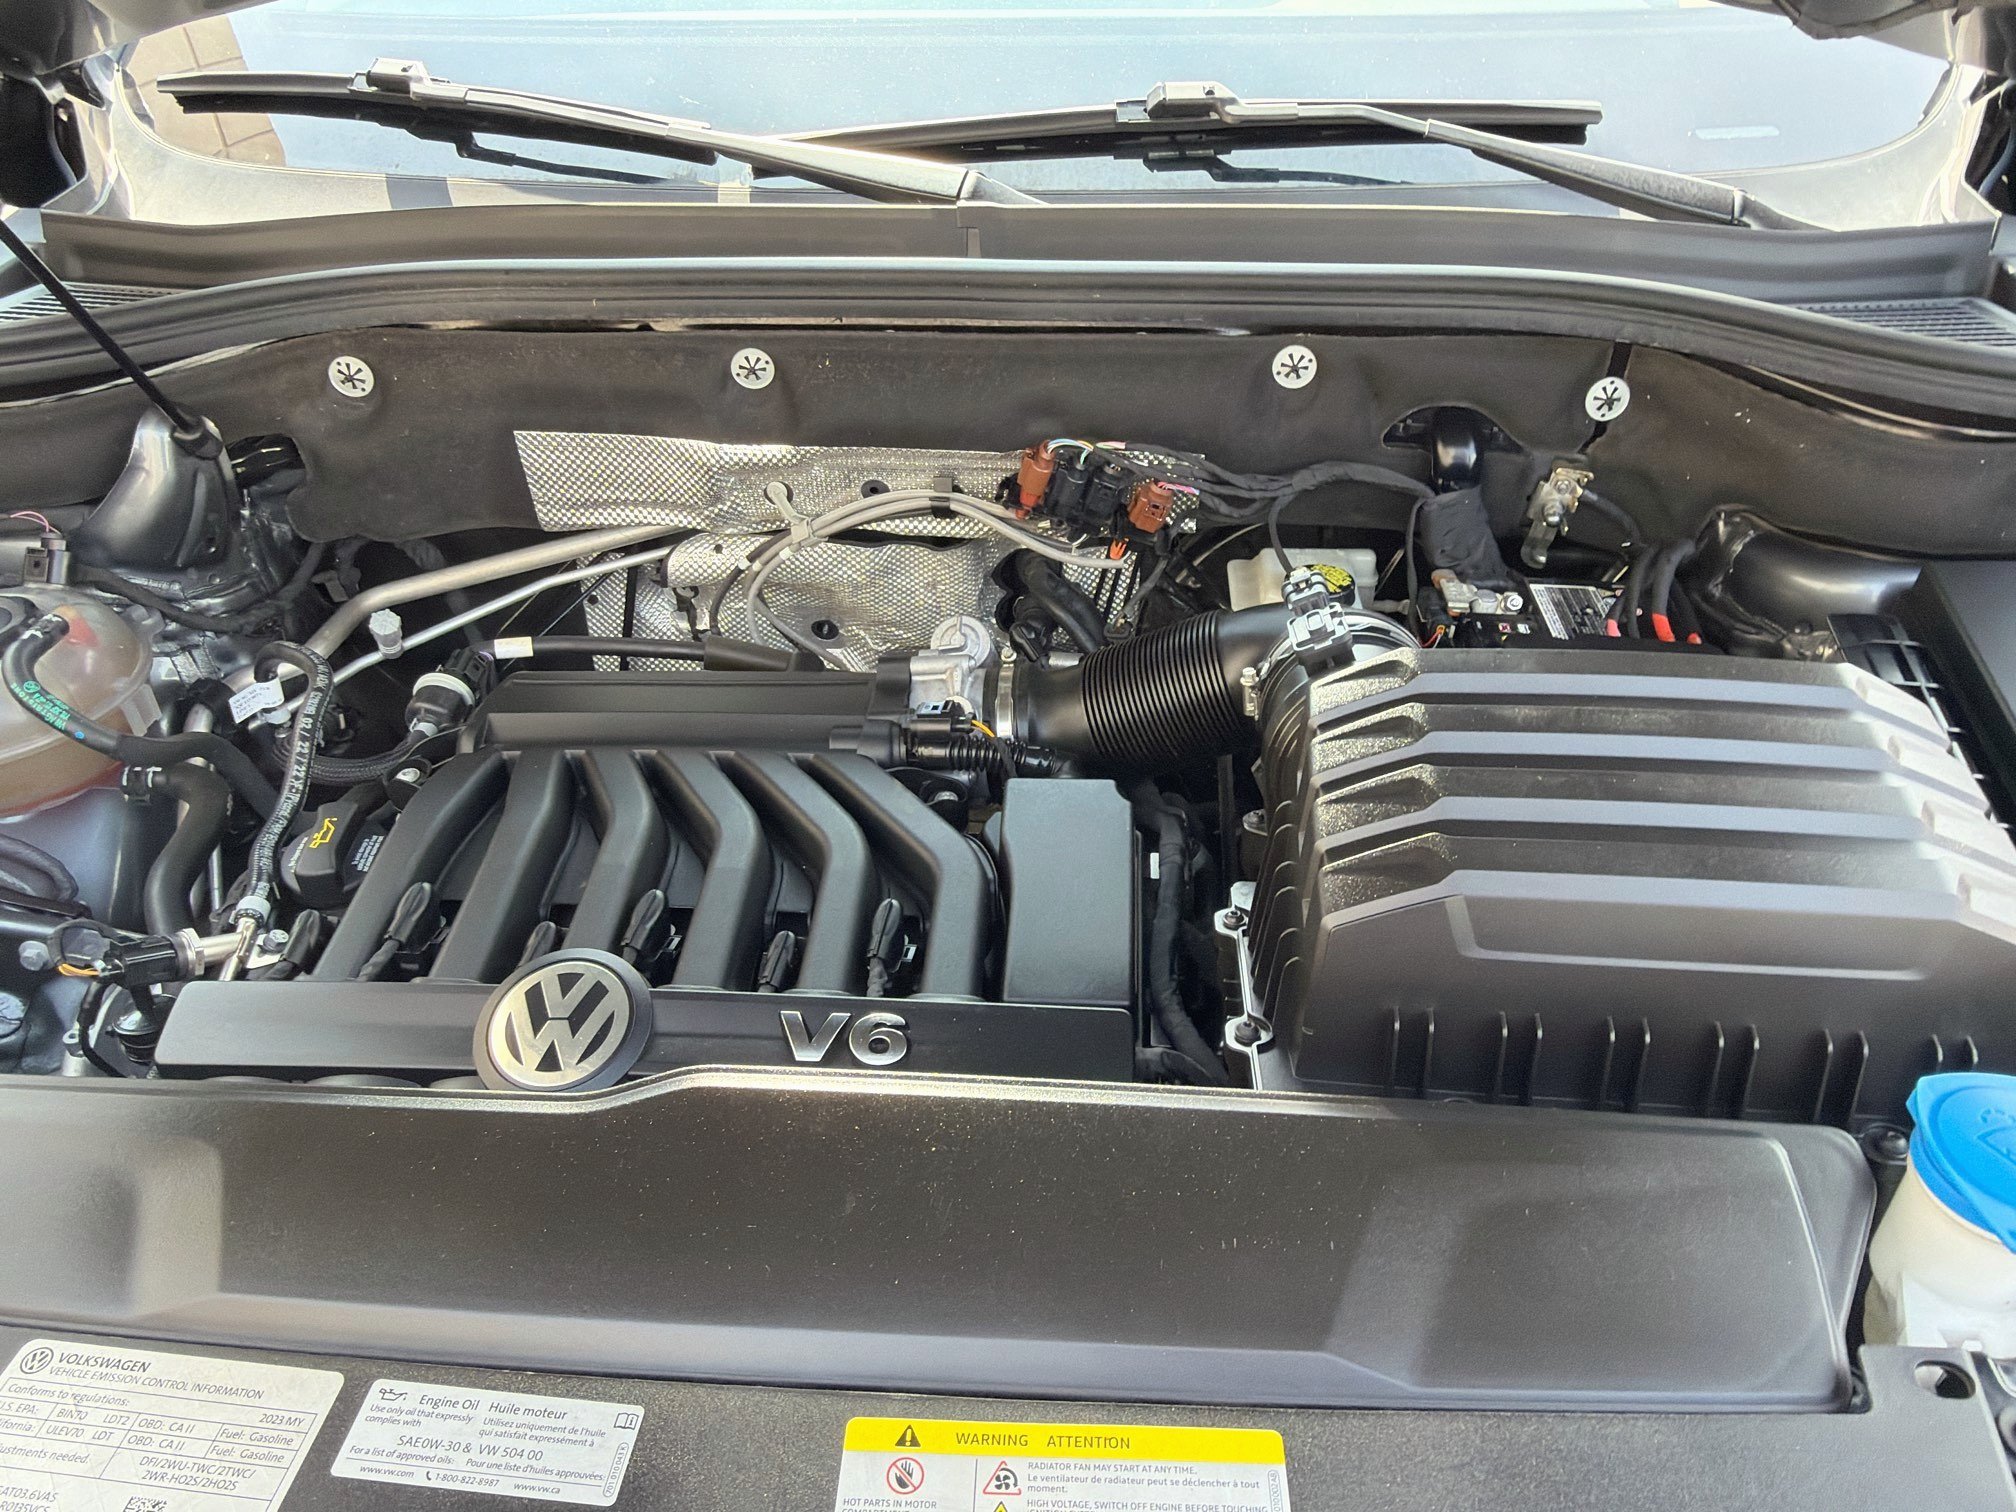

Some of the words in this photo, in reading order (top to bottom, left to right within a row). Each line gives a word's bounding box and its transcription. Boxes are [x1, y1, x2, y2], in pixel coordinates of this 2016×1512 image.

[778, 1009, 908, 1067] V6
[58, 1352, 152, 1373] VOLKSWAGEN
[49, 1366, 93, 1379] VEHICLE
[90, 1370, 142, 1385] EMISSION
[141, 1376, 189, 1391] CONTROL
[190, 1383, 265, 1400] INFORMATION
[8, 1383, 56, 1398] Conforms
[58, 1389, 69, 1400] to
[70, 1391, 130, 1407] regulations:
[419, 1394, 460, 1410] Engine
[461, 1399, 480, 1411] Oil
[15, 1403, 39, 1415] EPA:
[57, 1408, 88, 1421] BIN70
[103, 1413, 131, 1426] LDT2
[370, 1403, 386, 1413] Use
[386, 1405, 405, 1416] only
[405, 1407, 416, 1416] oil
[416, 1408, 435, 1418] that
[435, 1412, 474, 1425] expressly
[488, 1401, 521, 1415] Huile
[522, 1406, 568, 1420] moteur
[0, 1418, 36, 1432] ifornia:
[138, 1418, 165, 1431] OBD:
[169, 1421, 184, 1433] CA
[259, 1413, 285, 1425] 2023
[285, 1416, 306, 1427] MY
[364, 1414, 401, 1426] complies
[402, 1418, 422, 1427] with
[483, 1417, 514, 1428] Utilisez
[515, 1421, 568, 1435] uniquement
[567, 1425, 579, 1436] de
[579, 1427, 607, 1438] l'huile
[46, 1424, 85, 1438] ULEV70
[92, 1430, 115, 1442] LDT
[220, 1427, 245, 1440] Fuel:
[250, 1431, 294, 1446] Gasoline
[478, 1428, 493, 1440] qui
[494, 1429, 528, 1440] satisfait
[528, 1433, 588, 1447] expressément
[588, 1439, 595, 1448] à
[955, 1432, 1029, 1447] WARNING
[1046, 1434, 1131, 1449] ATTENTION
[127, 1434, 155, 1447] OBD:
[158, 1438, 174, 1450] CA
[48, 1451, 90, 1464] needed.
[209, 1444, 236, 1457] Fuel:
[240, 1448, 285, 1463] Gasoline
[349, 1445, 366, 1455] For
[371, 1447, 386, 1457] list
[385, 1448, 397, 1458] of
[396, 1452, 438, 1464] approved
[437, 1455, 455, 1465] oils:
[462, 1442, 473, 1454] &
[478, 1443, 501, 1457] VW
[501, 1446, 526, 1460] 504
[527, 1449, 544, 1461] 00
[359, 1465, 415, 1478] www.vw.com
[465, 1458, 487, 1468] Pour
[486, 1462, 504, 1470] une
[503, 1462, 522, 1472] liste
[522, 1464, 555, 1476] d'huiles
[1027, 1461, 1072, 1471] RADIATOR
[1073, 1462, 1091, 1472] FAN
[1093, 1463, 1112, 1472] MAY
[1113, 1464, 1141, 1473] START
[1141, 1464, 1153, 1474] AT
[1154, 1465, 1174, 1474] ANY
[1173, 1466, 1198, 1475] TIME.
[435, 1472, 500, 1487] 1-800-822-8987
[513, 1482, 561, 1494] www.vw.ca
[1027, 1473, 1038, 1482] Le
[1040, 1473, 1089, 1484] ventilateur
[1090, 1475, 1102, 1484] de
[1103, 1475, 1146, 1485] radiateur
[1147, 1477, 1168, 1487] peut
[1169, 1478, 1180, 1486] se
[1181, 1477, 1231, 1488] déclencher
[1232, 1479, 1239, 1488] à
[1240, 1480, 1260, 1489] tout
[1027, 1484, 1068, 1493] moment.
[843, 1498, 861, 1507] HOT
[863, 1498, 891, 1508] PARTS
[892, 1499, 903, 1508] IN
[904, 1500, 938, 1509] MOTOR
[1027, 1499, 1049, 1508] HIGH
[1049, 1500, 1093, 1510] VOLTAGE,
[1094, 1501, 1128, 1510] SWITCH
[1130, 1501, 1148, 1511] OFF
[1149, 1502, 1184, 1512] ENGINE
[1184, 1503, 1220, 1512] BEFORE
[1221, 1504, 1268, 1512] TOUCHING
